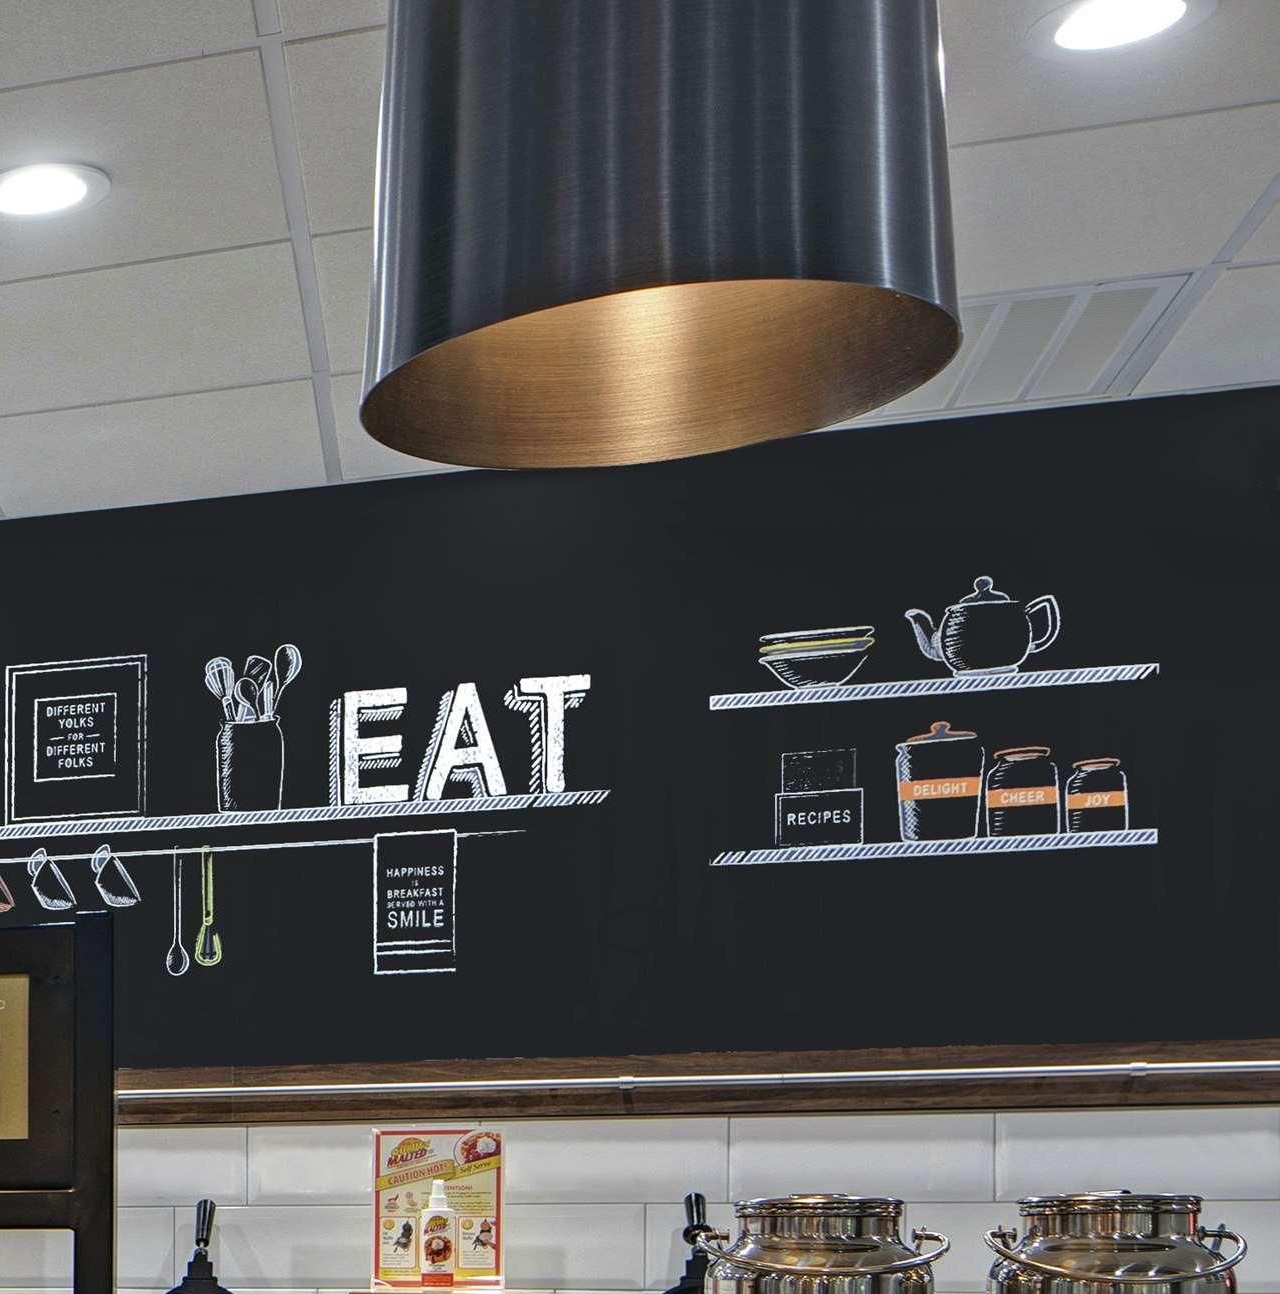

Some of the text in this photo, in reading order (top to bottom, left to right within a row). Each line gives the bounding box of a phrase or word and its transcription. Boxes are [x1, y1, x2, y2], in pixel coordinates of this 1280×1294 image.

[46, 702, 106, 717] DIFFERENT
[58, 716, 94, 729] YOLKS
[67, 732, 84, 741] FOR
[329, 674, 591, 806] EAT
[46, 742, 106, 757] DIFFERENT
[58, 756, 94, 769] FOLKS
[913, 782, 968, 797] DELIGHT
[1000, 791, 1045, 804] CHEER
[1084, 794, 1111, 806] JOY
[786, 809, 851, 826] RECIPES
[386, 865, 444, 878] HAPPINESS
[386, 887, 443, 899] BREAKFAST
[387, 909, 444, 929] SMILE
